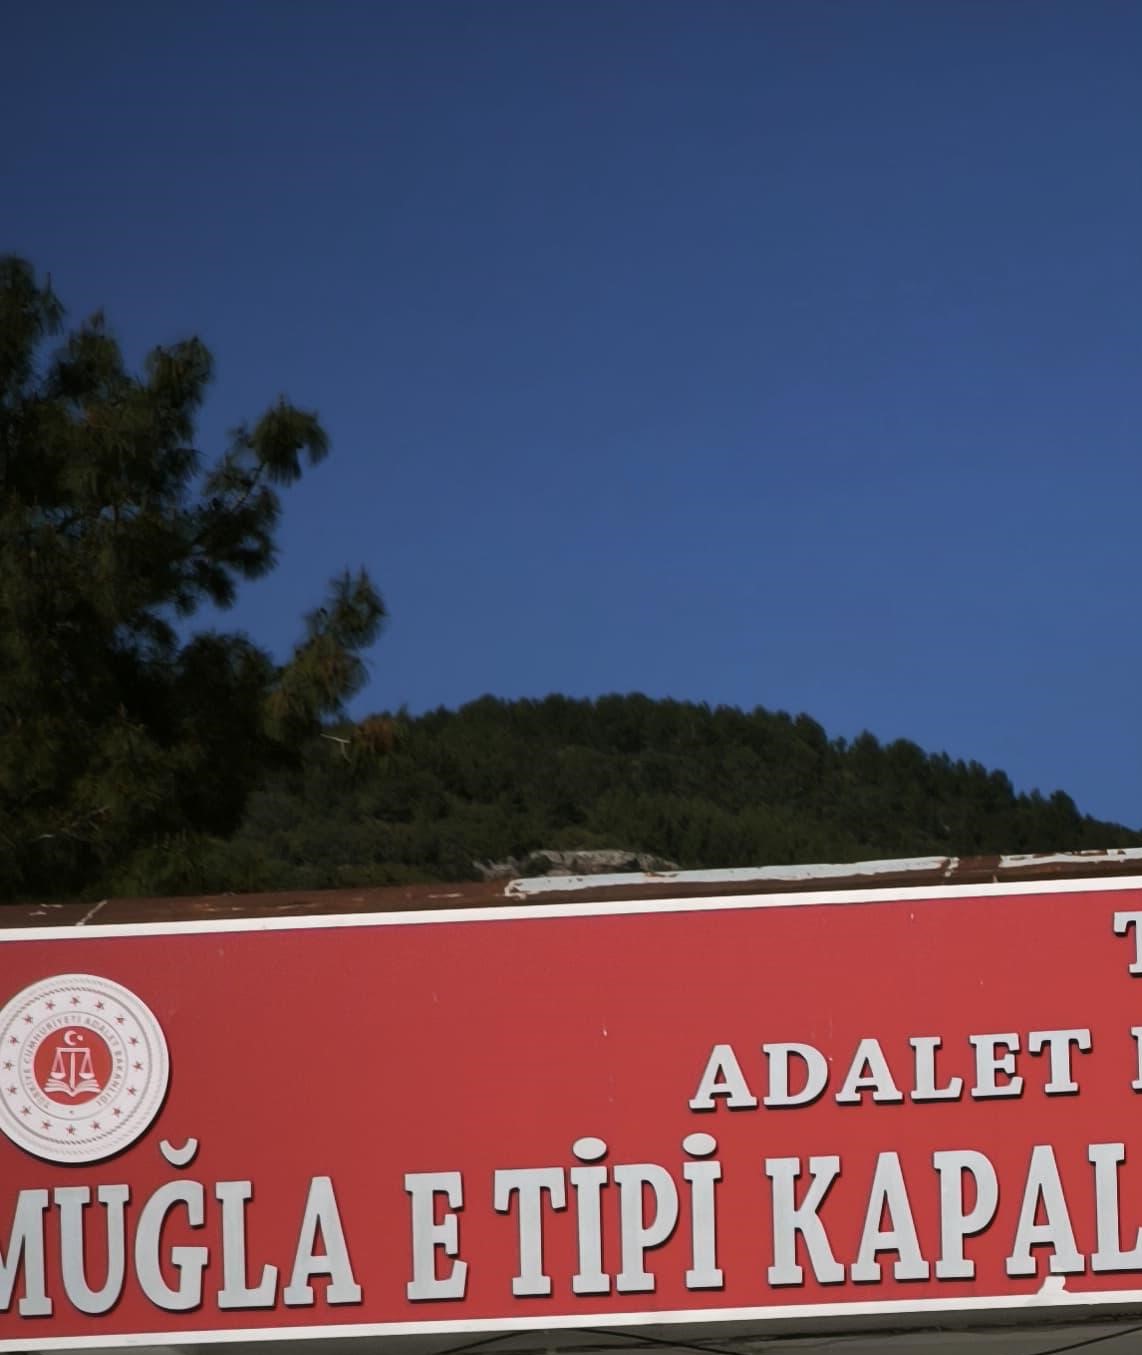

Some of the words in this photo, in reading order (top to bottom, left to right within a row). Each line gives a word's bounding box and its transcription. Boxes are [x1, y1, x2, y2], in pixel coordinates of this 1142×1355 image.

[688, 1029, 1092, 1110] ADALET
[0, 1137, 362, 1316] MUĞLA
[404, 1171, 468, 1300] E
[493, 1133, 723, 1296] TİPİ
